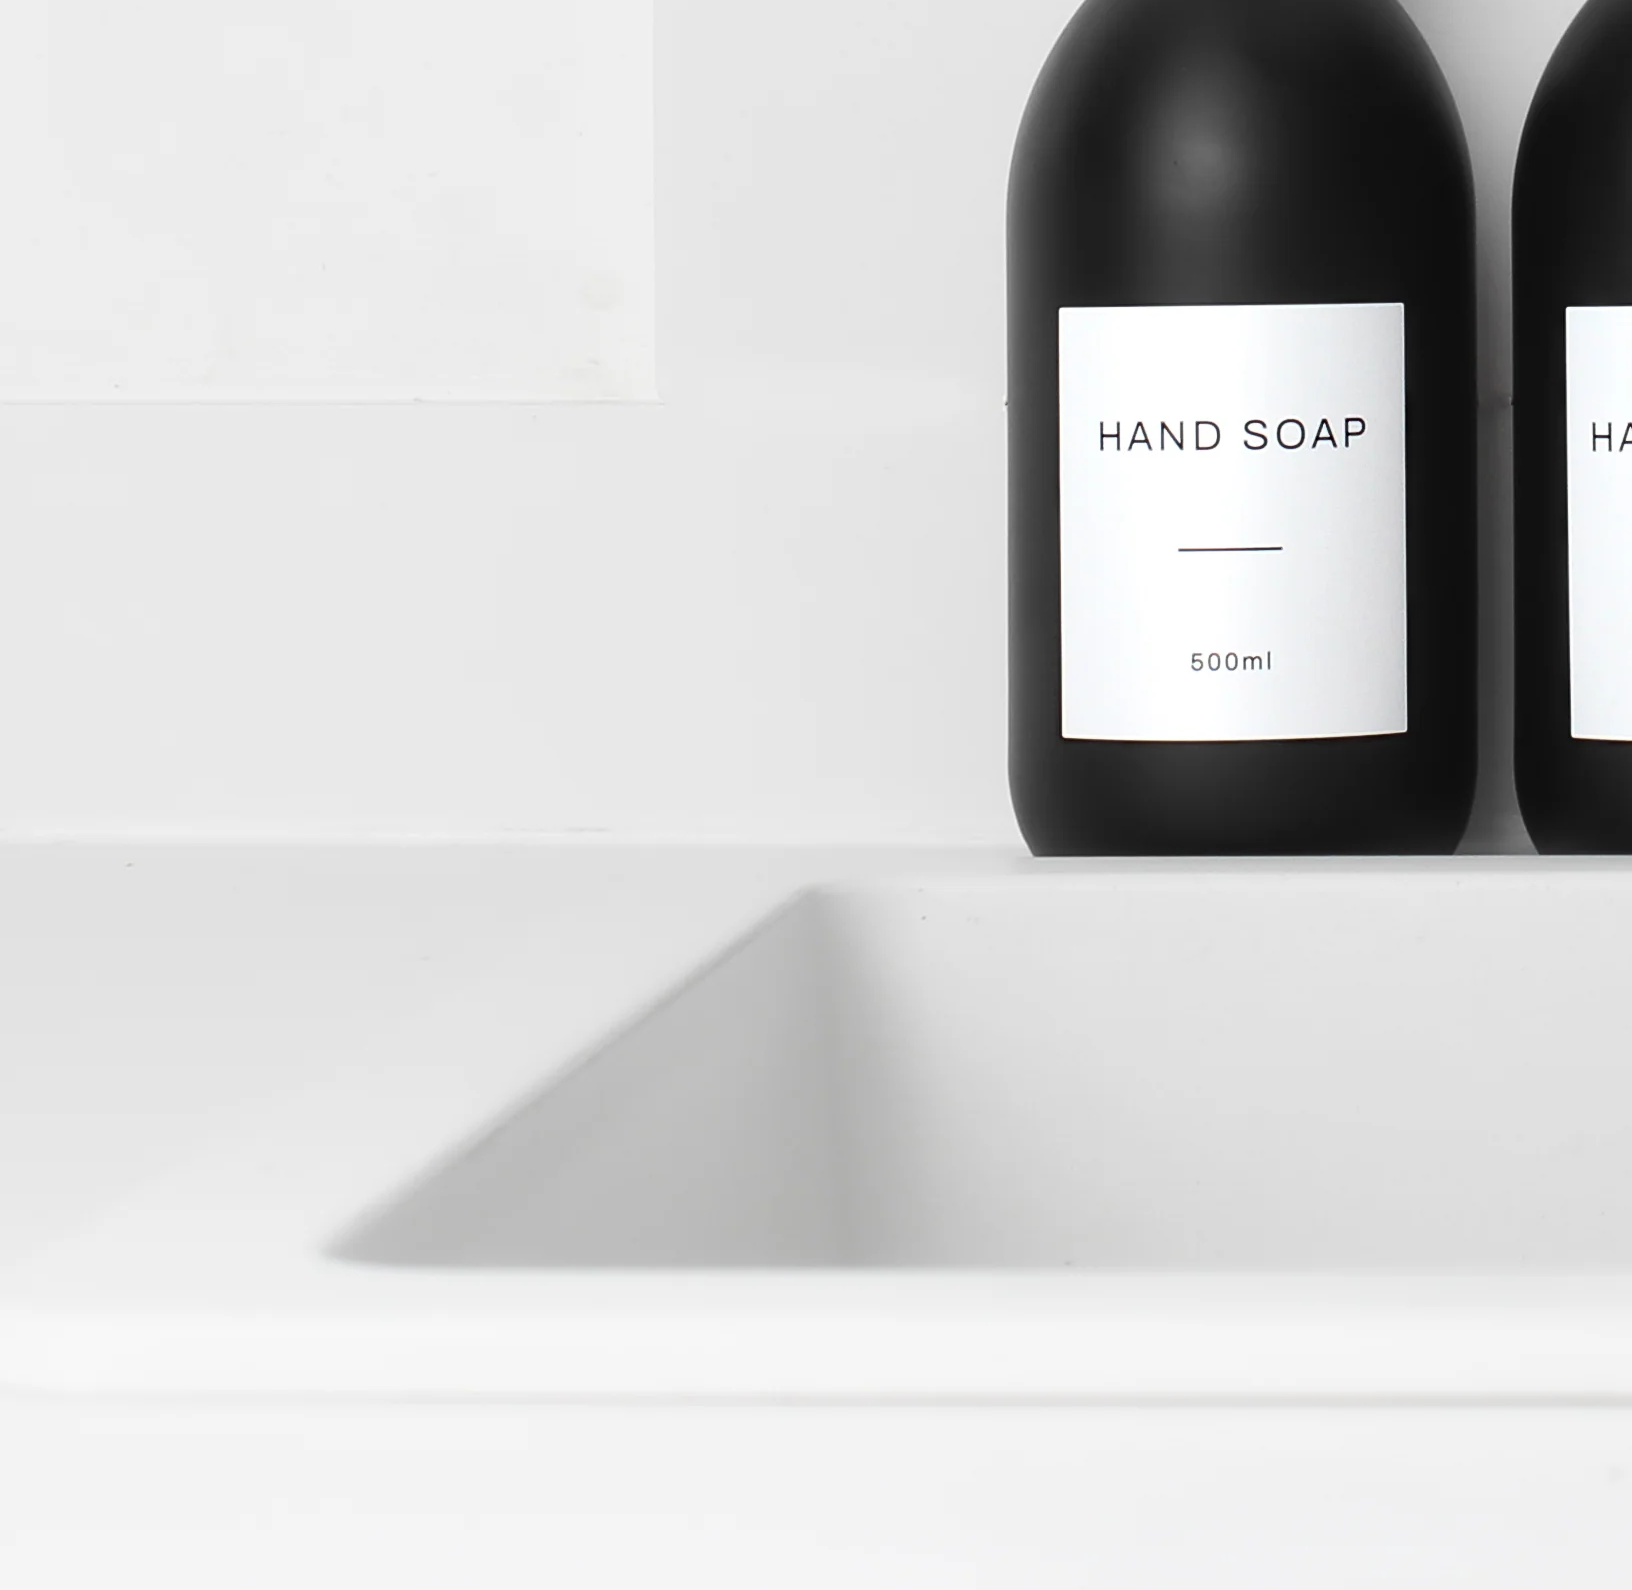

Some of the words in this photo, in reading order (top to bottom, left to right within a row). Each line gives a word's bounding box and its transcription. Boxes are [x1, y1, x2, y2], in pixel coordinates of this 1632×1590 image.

[1098, 420, 1222, 452] HAND
[1242, 416, 1367, 452] SOAP
[1190, 650, 1272, 672] 500ml
